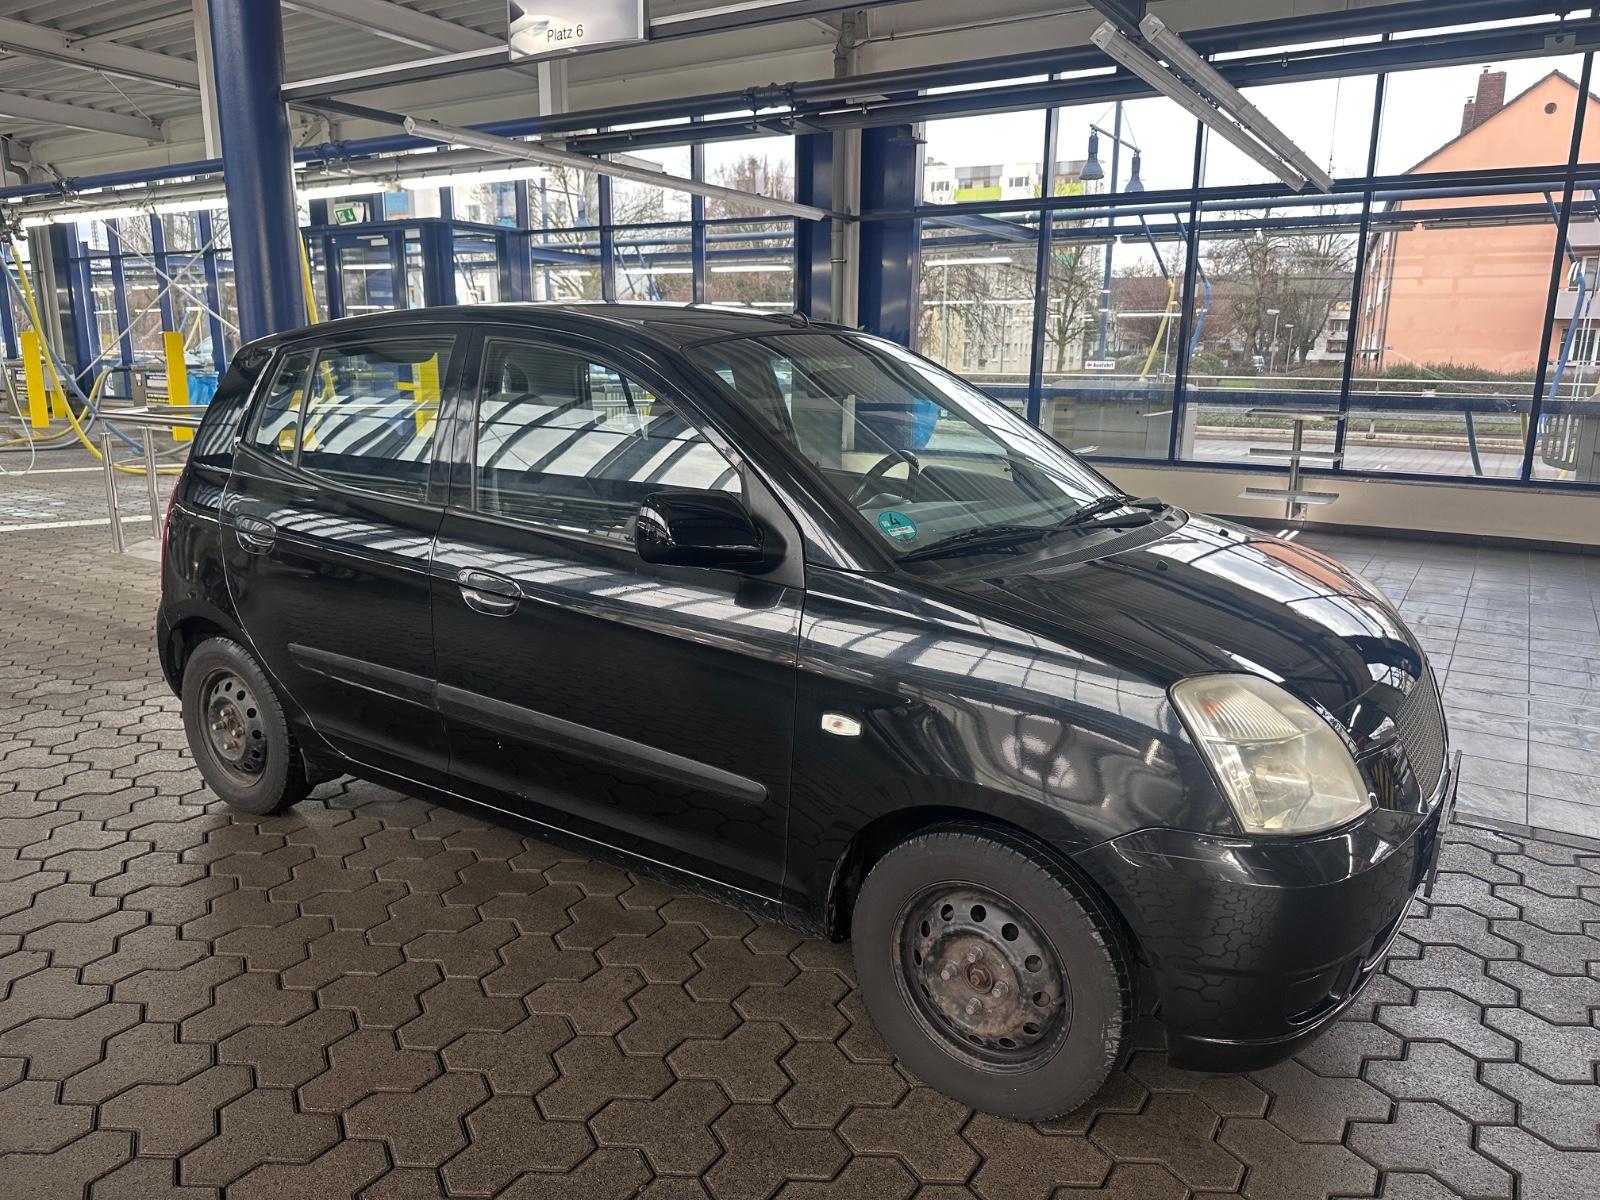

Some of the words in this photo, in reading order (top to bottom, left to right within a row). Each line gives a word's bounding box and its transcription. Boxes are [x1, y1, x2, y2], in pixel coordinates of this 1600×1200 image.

[547, 28, 573, 43] Platz
[576, 24, 584, 38] 6
[889, 513, 901, 525] 4
